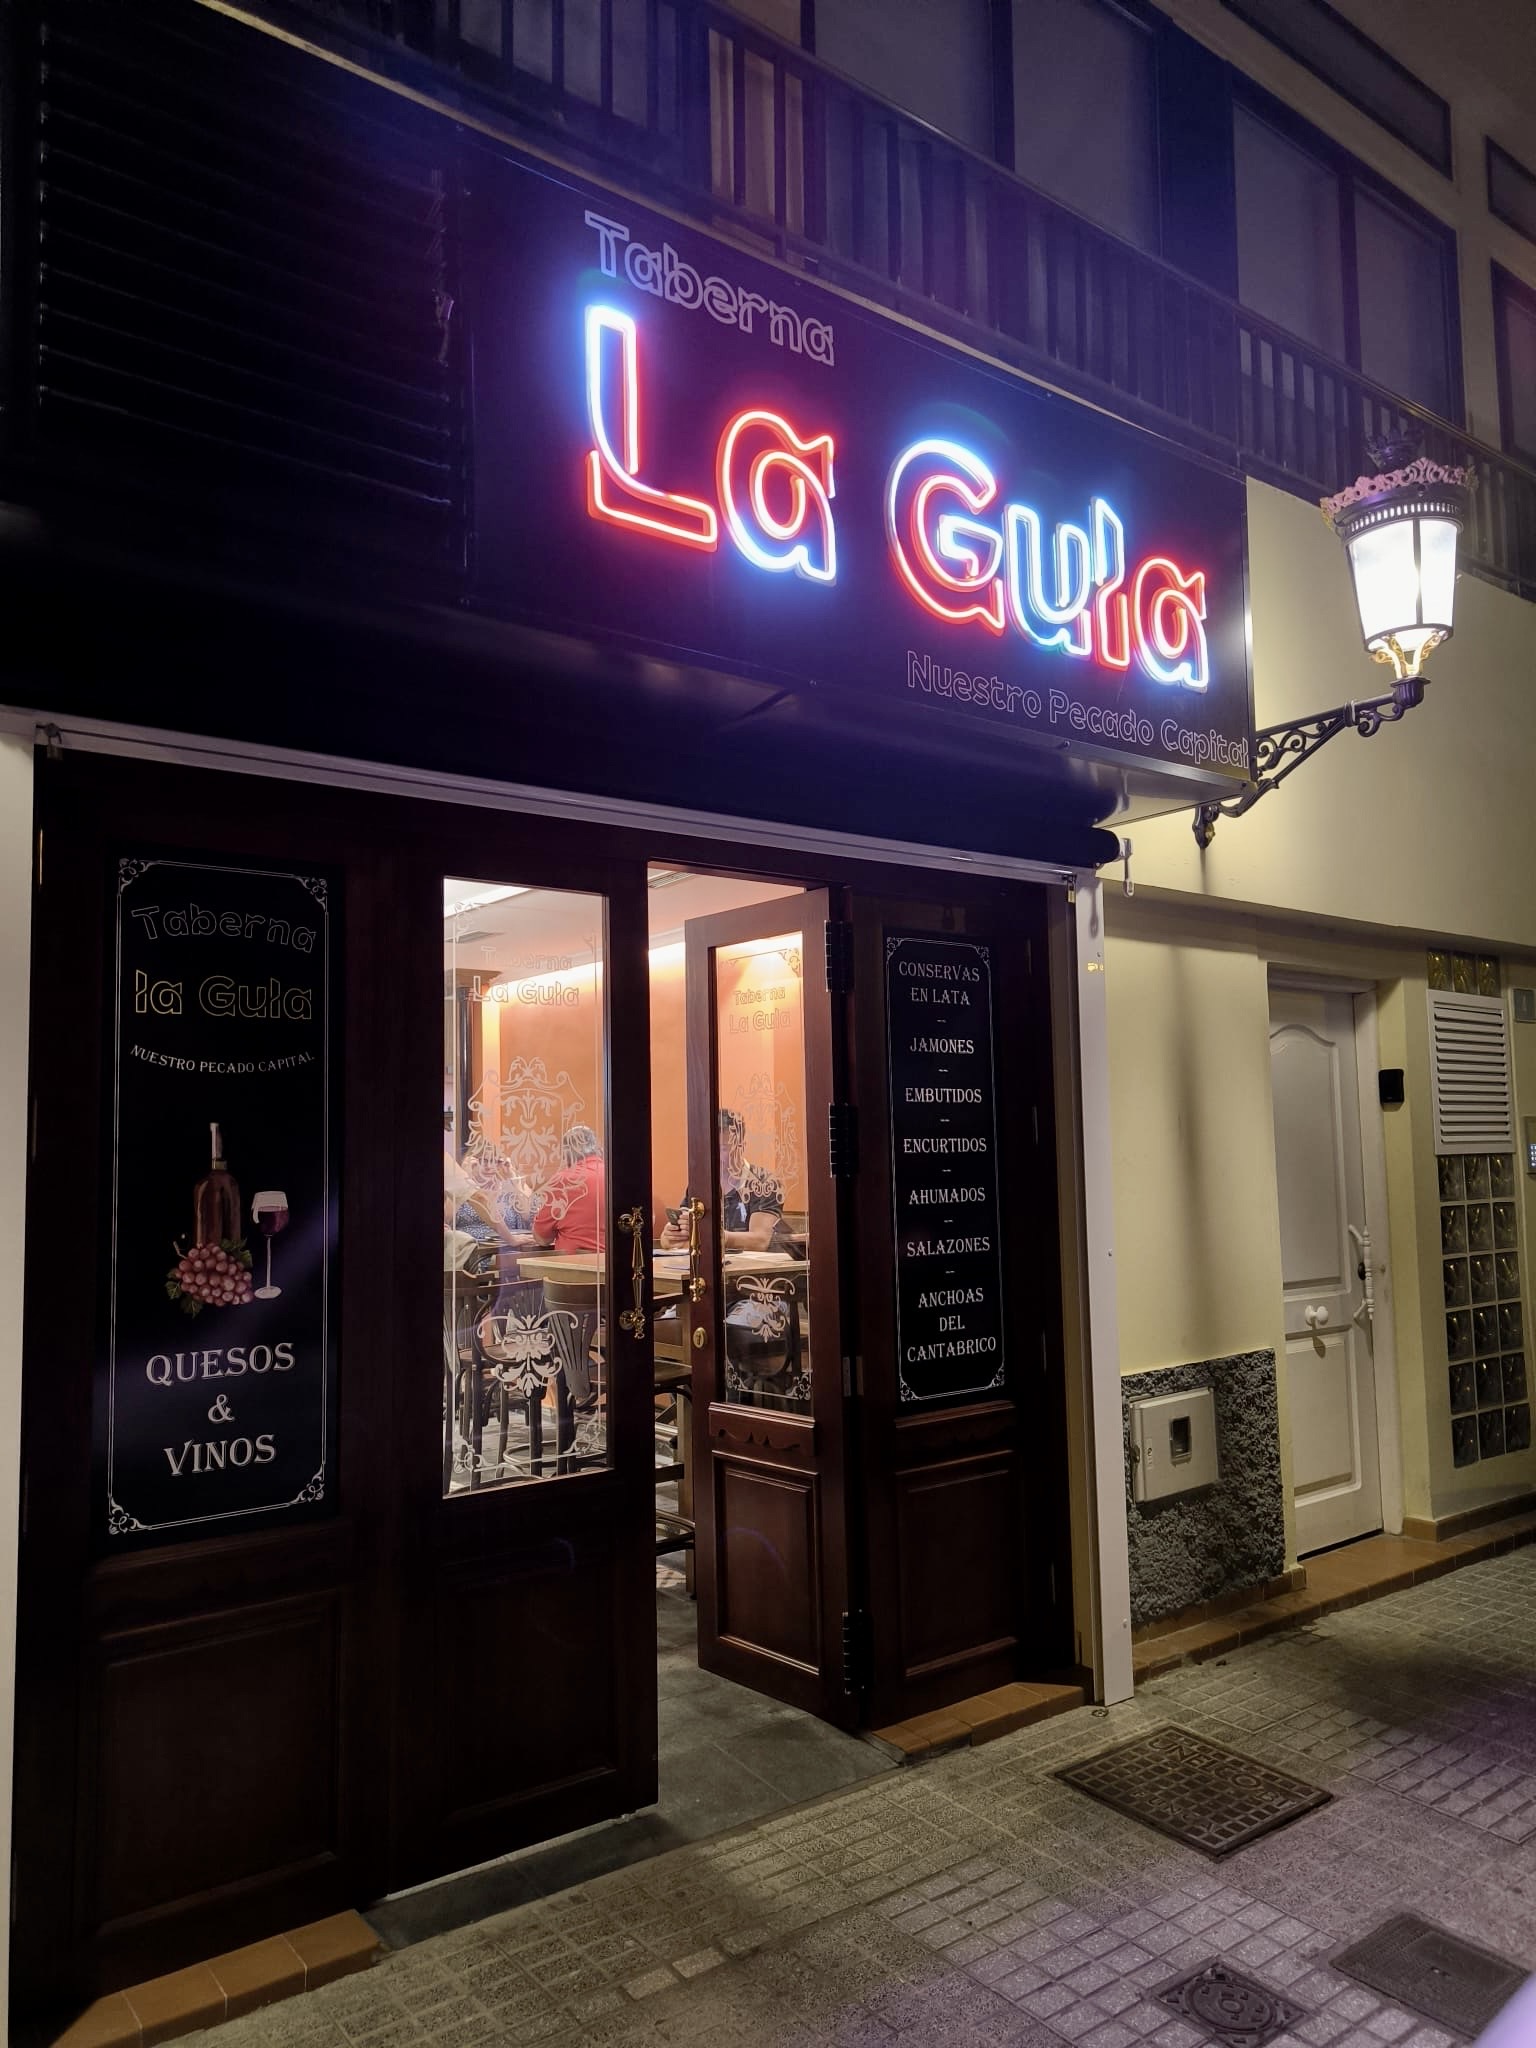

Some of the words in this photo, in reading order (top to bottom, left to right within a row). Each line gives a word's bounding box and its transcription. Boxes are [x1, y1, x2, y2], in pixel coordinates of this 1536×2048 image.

[585, 210, 835, 366] Taberna
[585, 304, 837, 587] La
[885, 439, 1209, 693] Gula
[907, 651, 1041, 718] Nuestro
[1050, 689, 1154, 745] Pecado
[1161, 719, 1250, 769] Capital
[131, 903, 316, 953] Taberna
[899, 961, 980, 982] CONSERVAS
[135, 969, 183, 1015] la
[199, 975, 312, 1020] Gula
[473, 975, 509, 1003] La
[517, 979, 580, 1007] Gula
[734, 987, 786, 1006] Taberna
[911, 987, 928, 1002] EN
[933, 989, 971, 1006] LATA
[753, 1008, 792, 1032] Gula
[910, 1037, 975, 1055] JAMONES
[130, 1044, 196, 1071] NUESTRO
[199, 1061, 255, 1074] PECADO
[258, 1051, 315, 1073] CAPITAL
[905, 1087, 983, 1104] EMBUTIDOS
[904, 1138, 988, 1154] ENCURTIDOS
[909, 1187, 986, 1205] AHUMADOS
[907, 1236, 991, 1257] SALAZONES
[918, 1288, 984, 1309] ANCHOAS
[939, 1315, 966, 1332] DEL
[907, 1336, 997, 1362] CANTABRICO
[146, 1342, 296, 1388] QUESOS
[207, 1394, 236, 1424] &
[163, 1434, 277, 1477] VINOS
